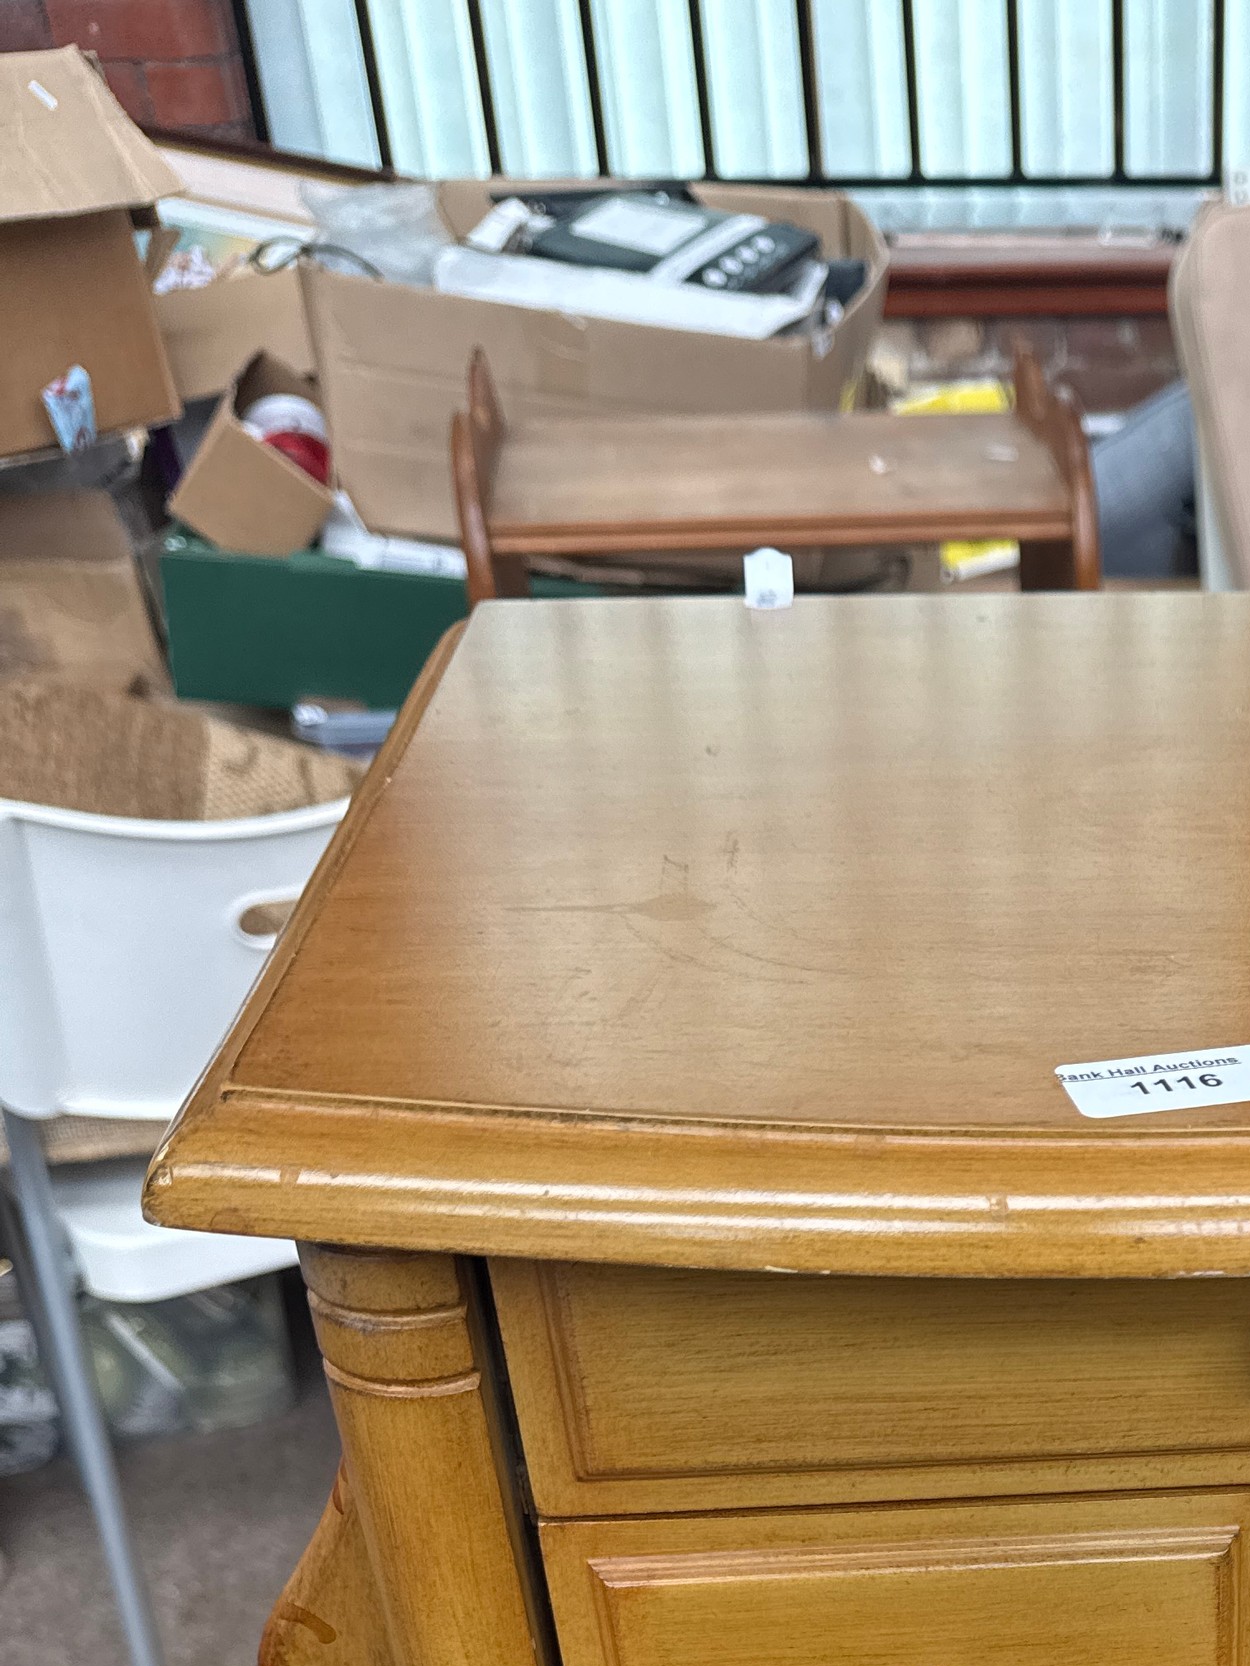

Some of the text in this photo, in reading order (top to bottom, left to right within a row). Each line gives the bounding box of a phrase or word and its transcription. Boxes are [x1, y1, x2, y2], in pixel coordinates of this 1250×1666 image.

[1108, 1066, 1147, 1078] Hall
[1152, 1055, 1240, 1073] Auctions
[1130, 1073, 1224, 1095] 1116
